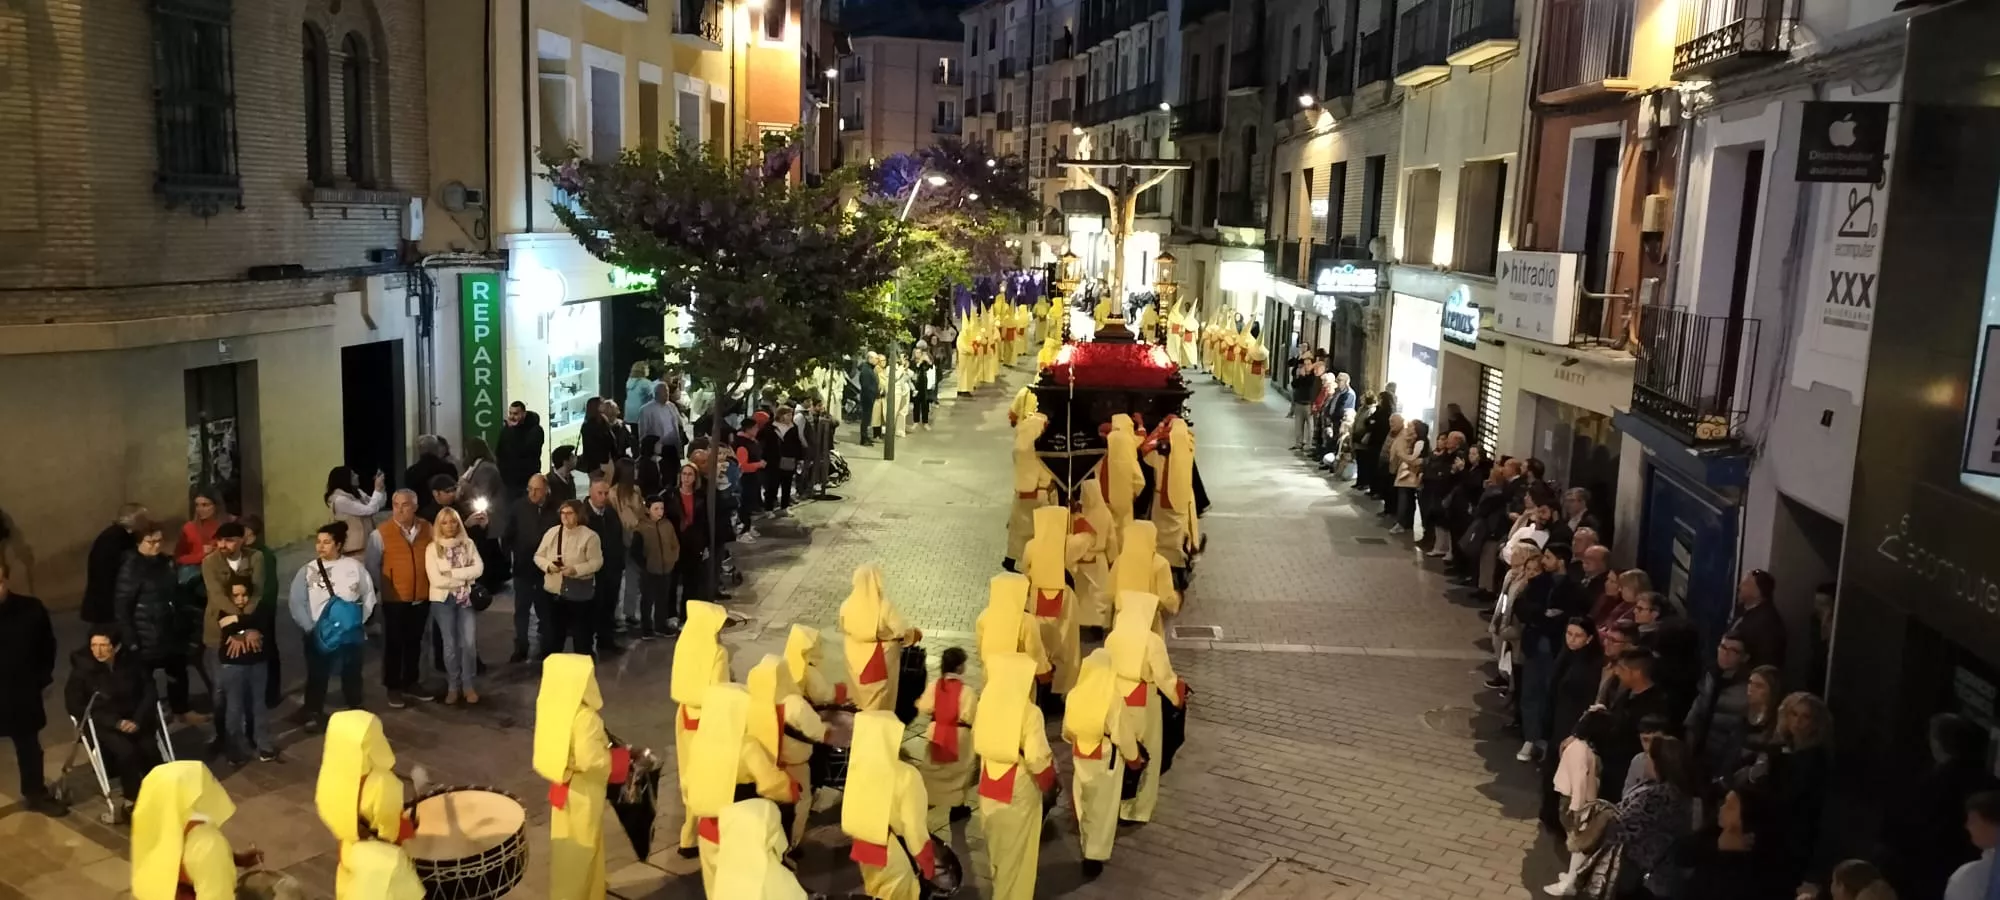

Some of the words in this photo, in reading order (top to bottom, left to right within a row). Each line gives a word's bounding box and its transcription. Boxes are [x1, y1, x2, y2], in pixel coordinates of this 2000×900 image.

[1510, 258, 1556, 288] hitradio
[1826, 270, 1876, 308] XXX
[1905, 541, 2000, 615] ecompute
